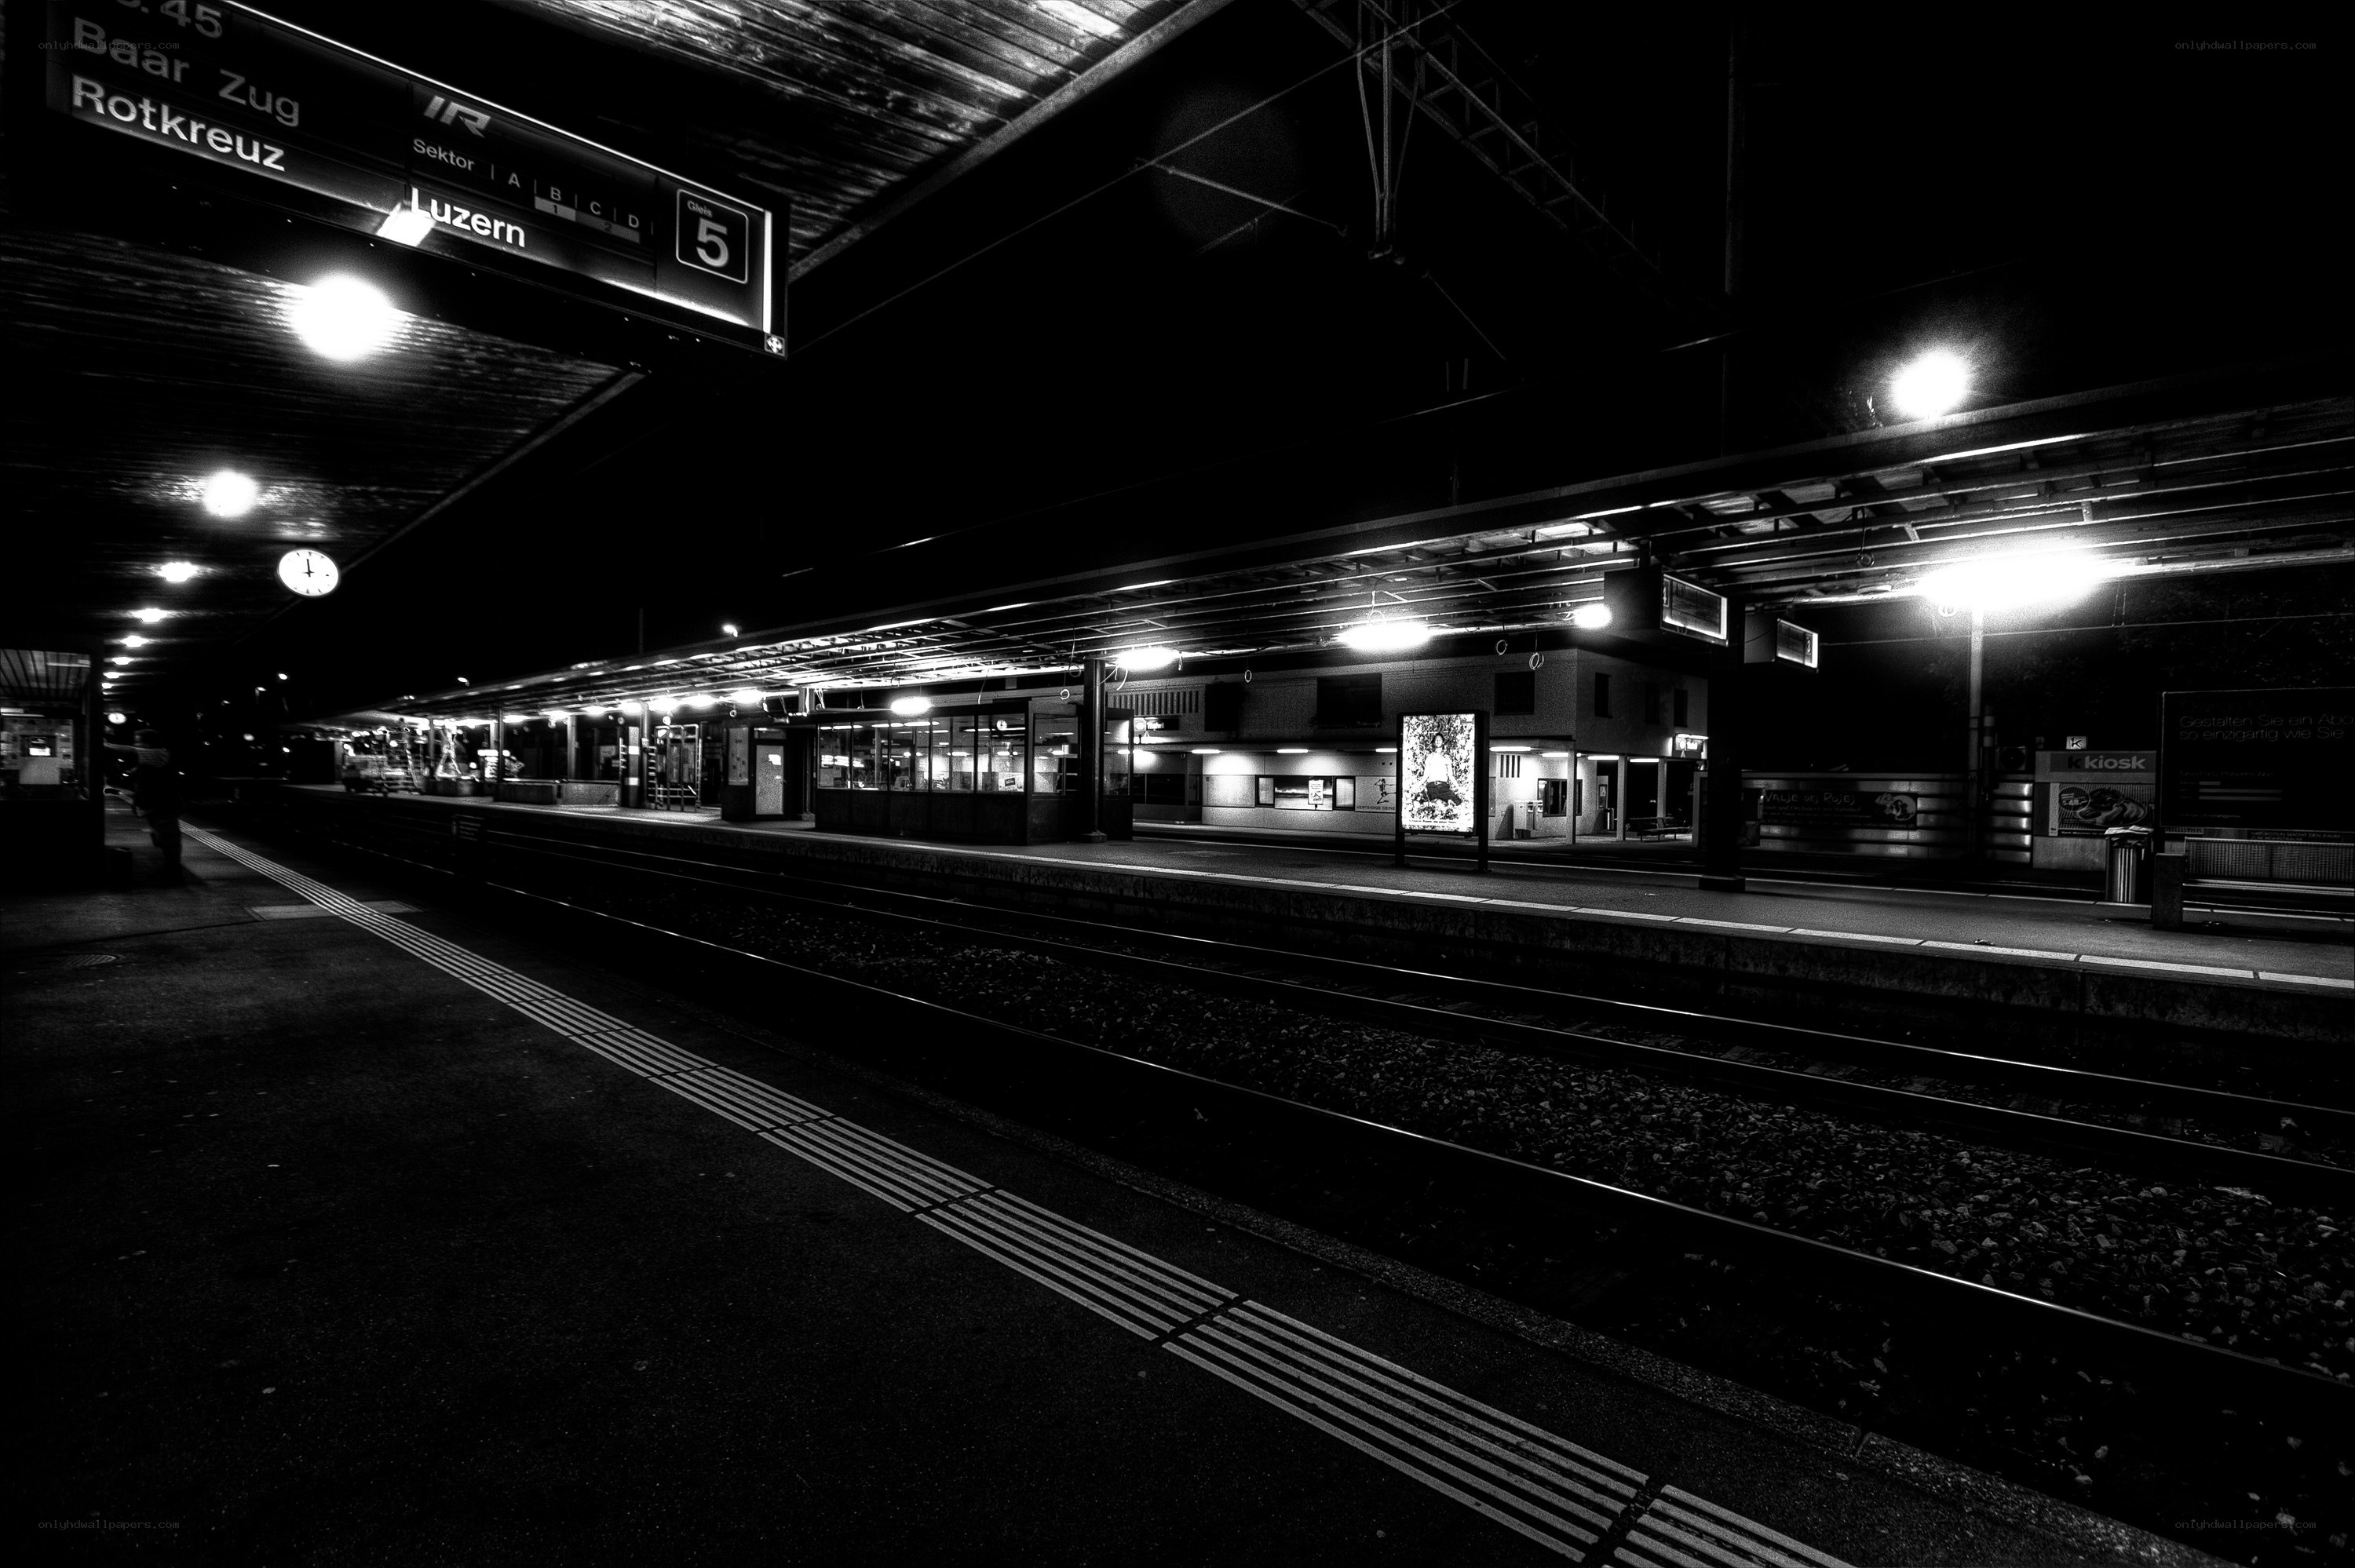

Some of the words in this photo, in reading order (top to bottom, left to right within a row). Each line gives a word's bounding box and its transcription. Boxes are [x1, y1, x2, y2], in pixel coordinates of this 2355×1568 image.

[115, 0, 222, 38] .45
[74, 16, 190, 83] Baar
[218, 68, 300, 128] Zug
[71, 74, 286, 172] Rotkreuz
[412, 137, 476, 171] Sektor
[507, 173, 521, 189] A
[550, 186, 561, 202] B
[590, 200, 601, 215] C
[629, 213, 640, 228] D
[411, 187, 525, 248] Luzern
[553, 204, 558, 215] 1
[696, 217, 731, 268] 5
[2179, 715, 2252, 727] Gestalten
[2258, 714, 2284, 727] Sie
[2288, 715, 2313, 726] ein
[2317, 713, 2354, 725] Abo
[2179, 731, 2199, 741] so
[2203, 728, 2278, 742] einzigartig
[2284, 728, 2312, 739] wie
[2317, 726, 2344, 739] Sie
[2068, 756, 2082, 769] k
[2084, 755, 2147, 769] kiosk
